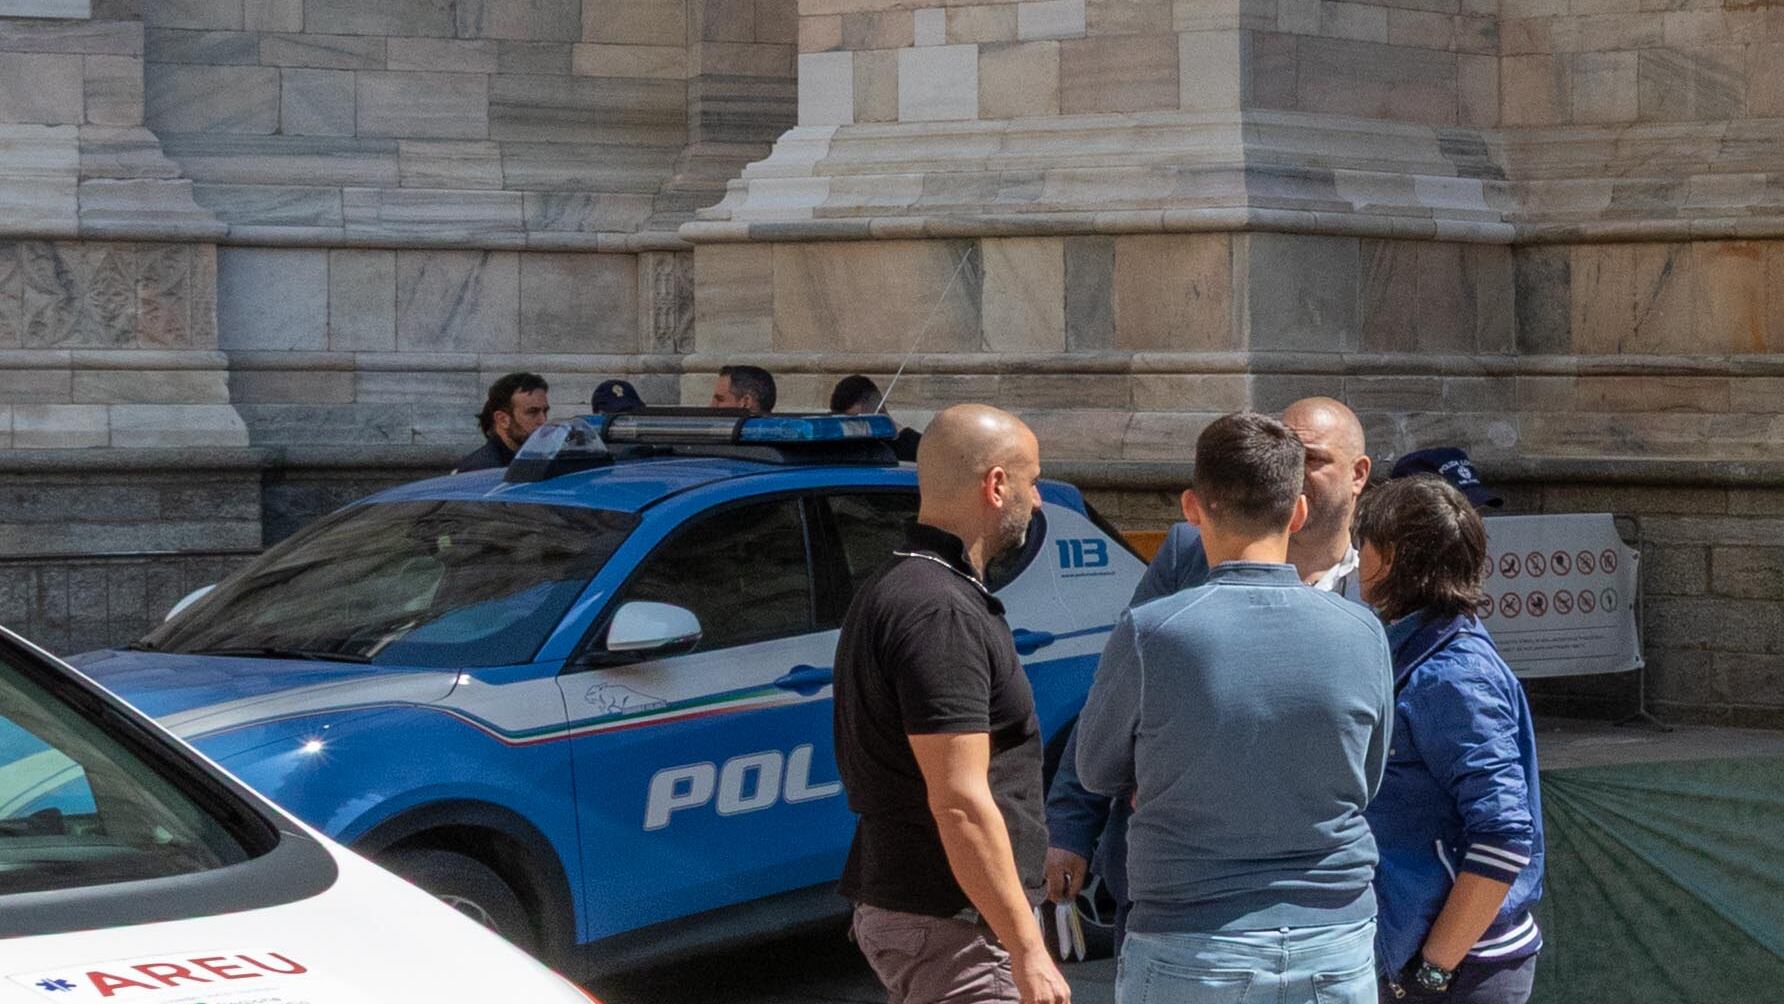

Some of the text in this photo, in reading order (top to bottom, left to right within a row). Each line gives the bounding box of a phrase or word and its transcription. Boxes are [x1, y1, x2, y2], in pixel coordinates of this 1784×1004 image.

[1055, 538, 1109, 569] 113
[643, 744, 844, 832] POL
[85, 952, 308, 997] AREU
